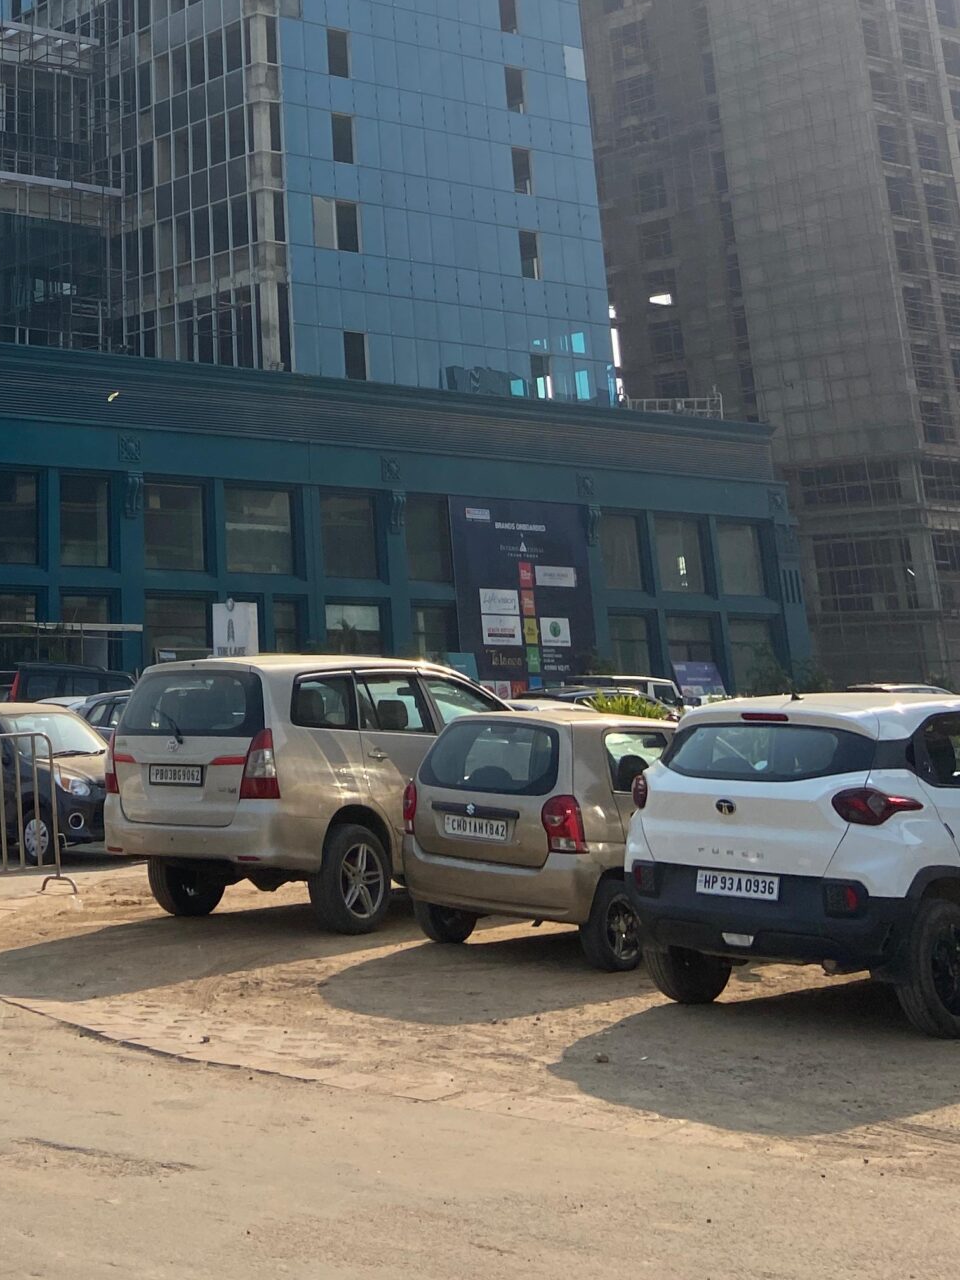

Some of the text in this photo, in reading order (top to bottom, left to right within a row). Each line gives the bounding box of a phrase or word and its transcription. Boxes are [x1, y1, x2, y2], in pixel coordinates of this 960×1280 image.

[703, 874, 774, 895] HP 93 A 0936
